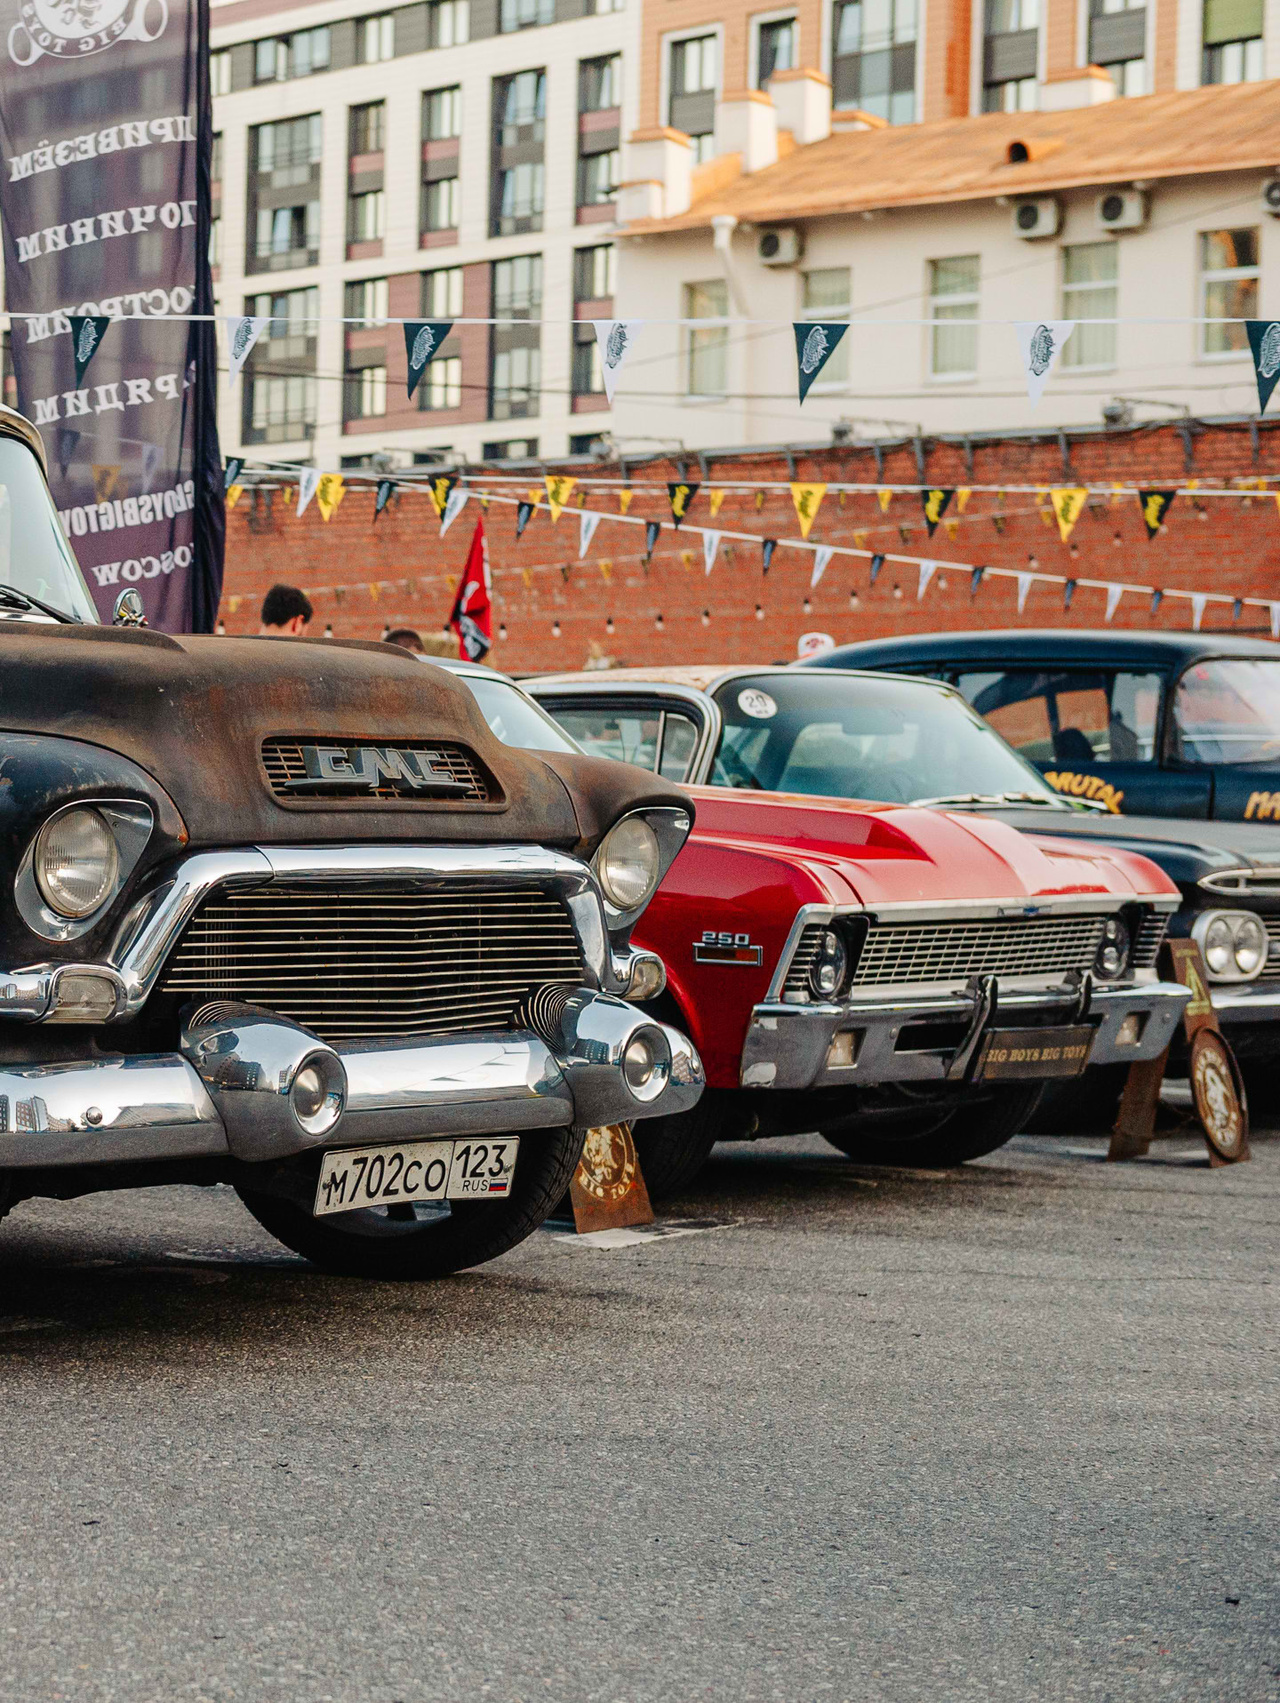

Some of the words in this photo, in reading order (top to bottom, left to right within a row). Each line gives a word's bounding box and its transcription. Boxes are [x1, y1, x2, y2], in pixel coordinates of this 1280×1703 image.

[302, 746, 455, 789] GMC
[702, 930, 750, 946] 250
[986, 1049, 1008, 1062] BIG
[1009, 1048, 1040, 1062] BOYS
[1041, 1047, 1061, 1061] BIG
[456, 1144, 508, 1178] 123
[462, 1179, 488, 1192] RUS
